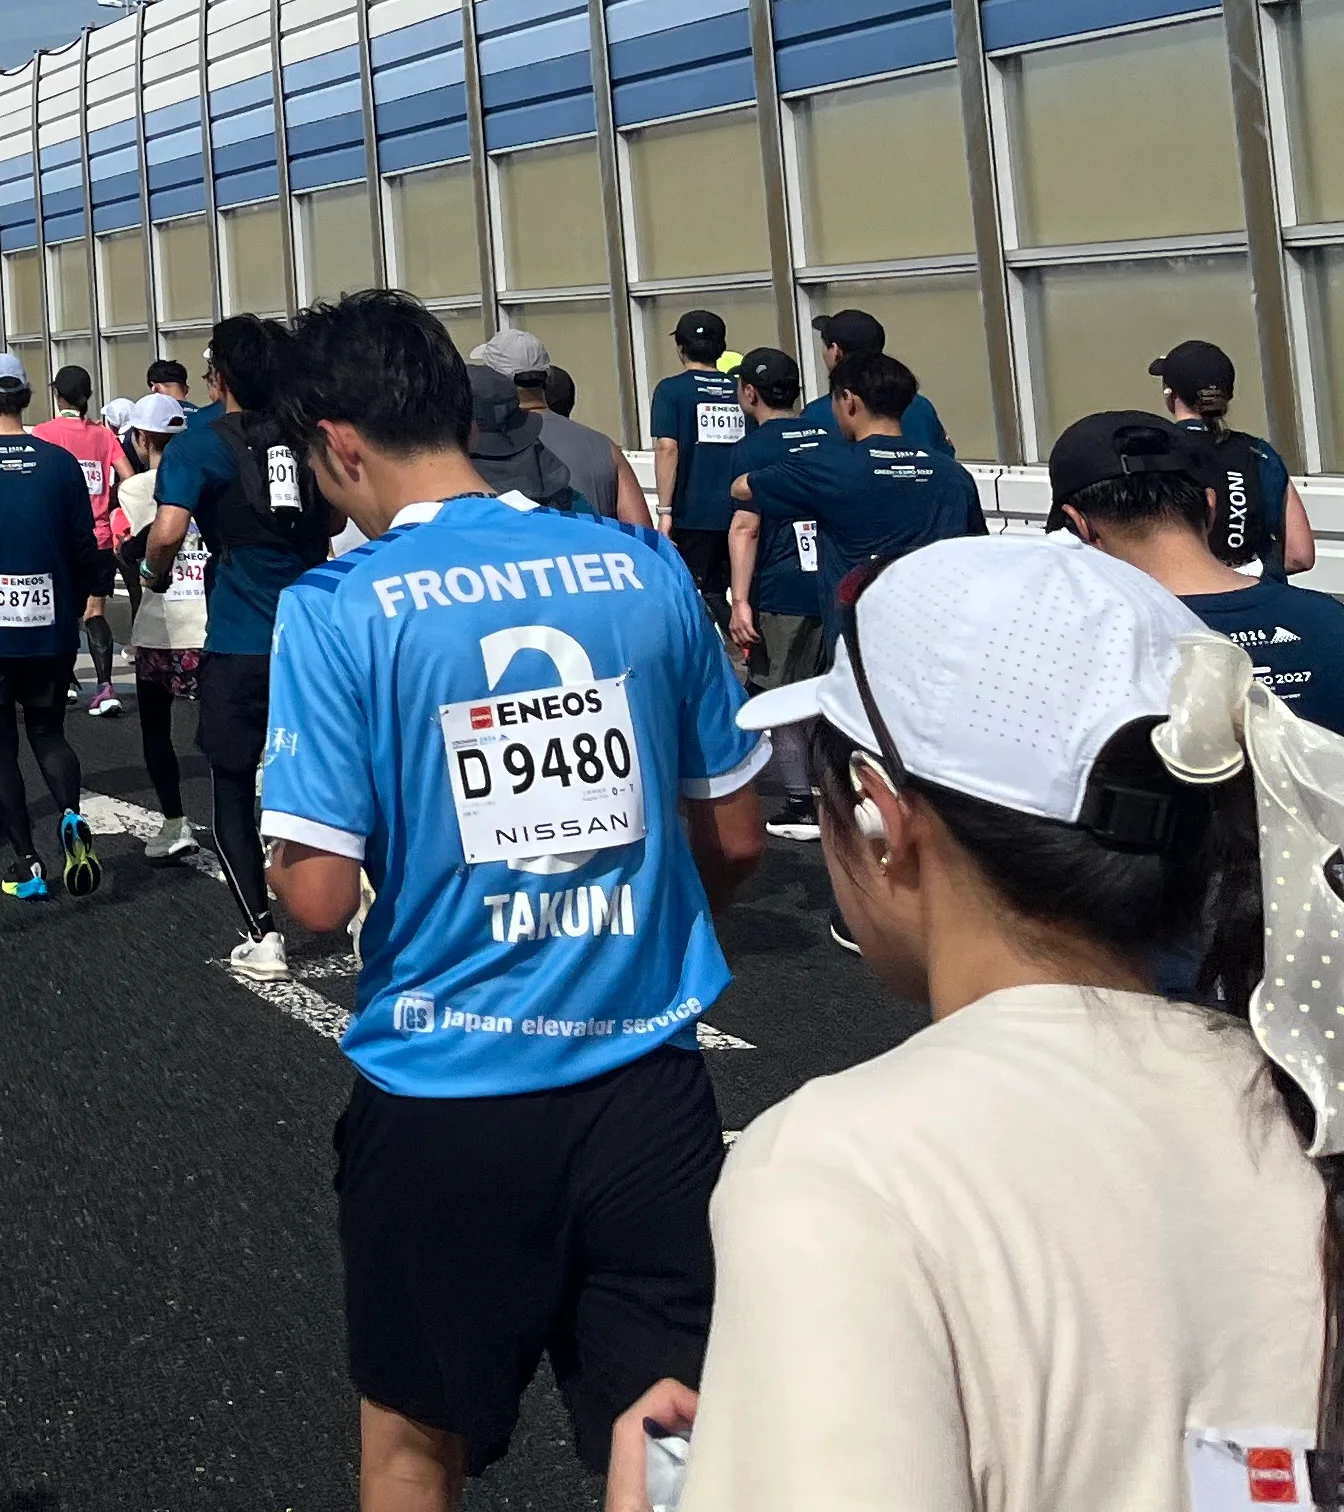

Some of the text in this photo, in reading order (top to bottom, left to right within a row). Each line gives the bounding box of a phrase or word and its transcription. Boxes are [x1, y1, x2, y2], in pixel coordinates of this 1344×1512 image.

[1226, 471, 1248, 549] INOXTO
[9, 576, 45, 585] ENEOS
[372, 552, 645, 619] FRONTIER
[1276, 671, 1312, 685] 2027
[496, 688, 603, 727] ENEOS
[495, 811, 630, 846] NISSAN
[483, 884, 637, 944] TAKUMI
[441, 1006, 513, 1033] japan
[521, 1014, 616, 1037] elevator
[622, 996, 704, 1035] service
